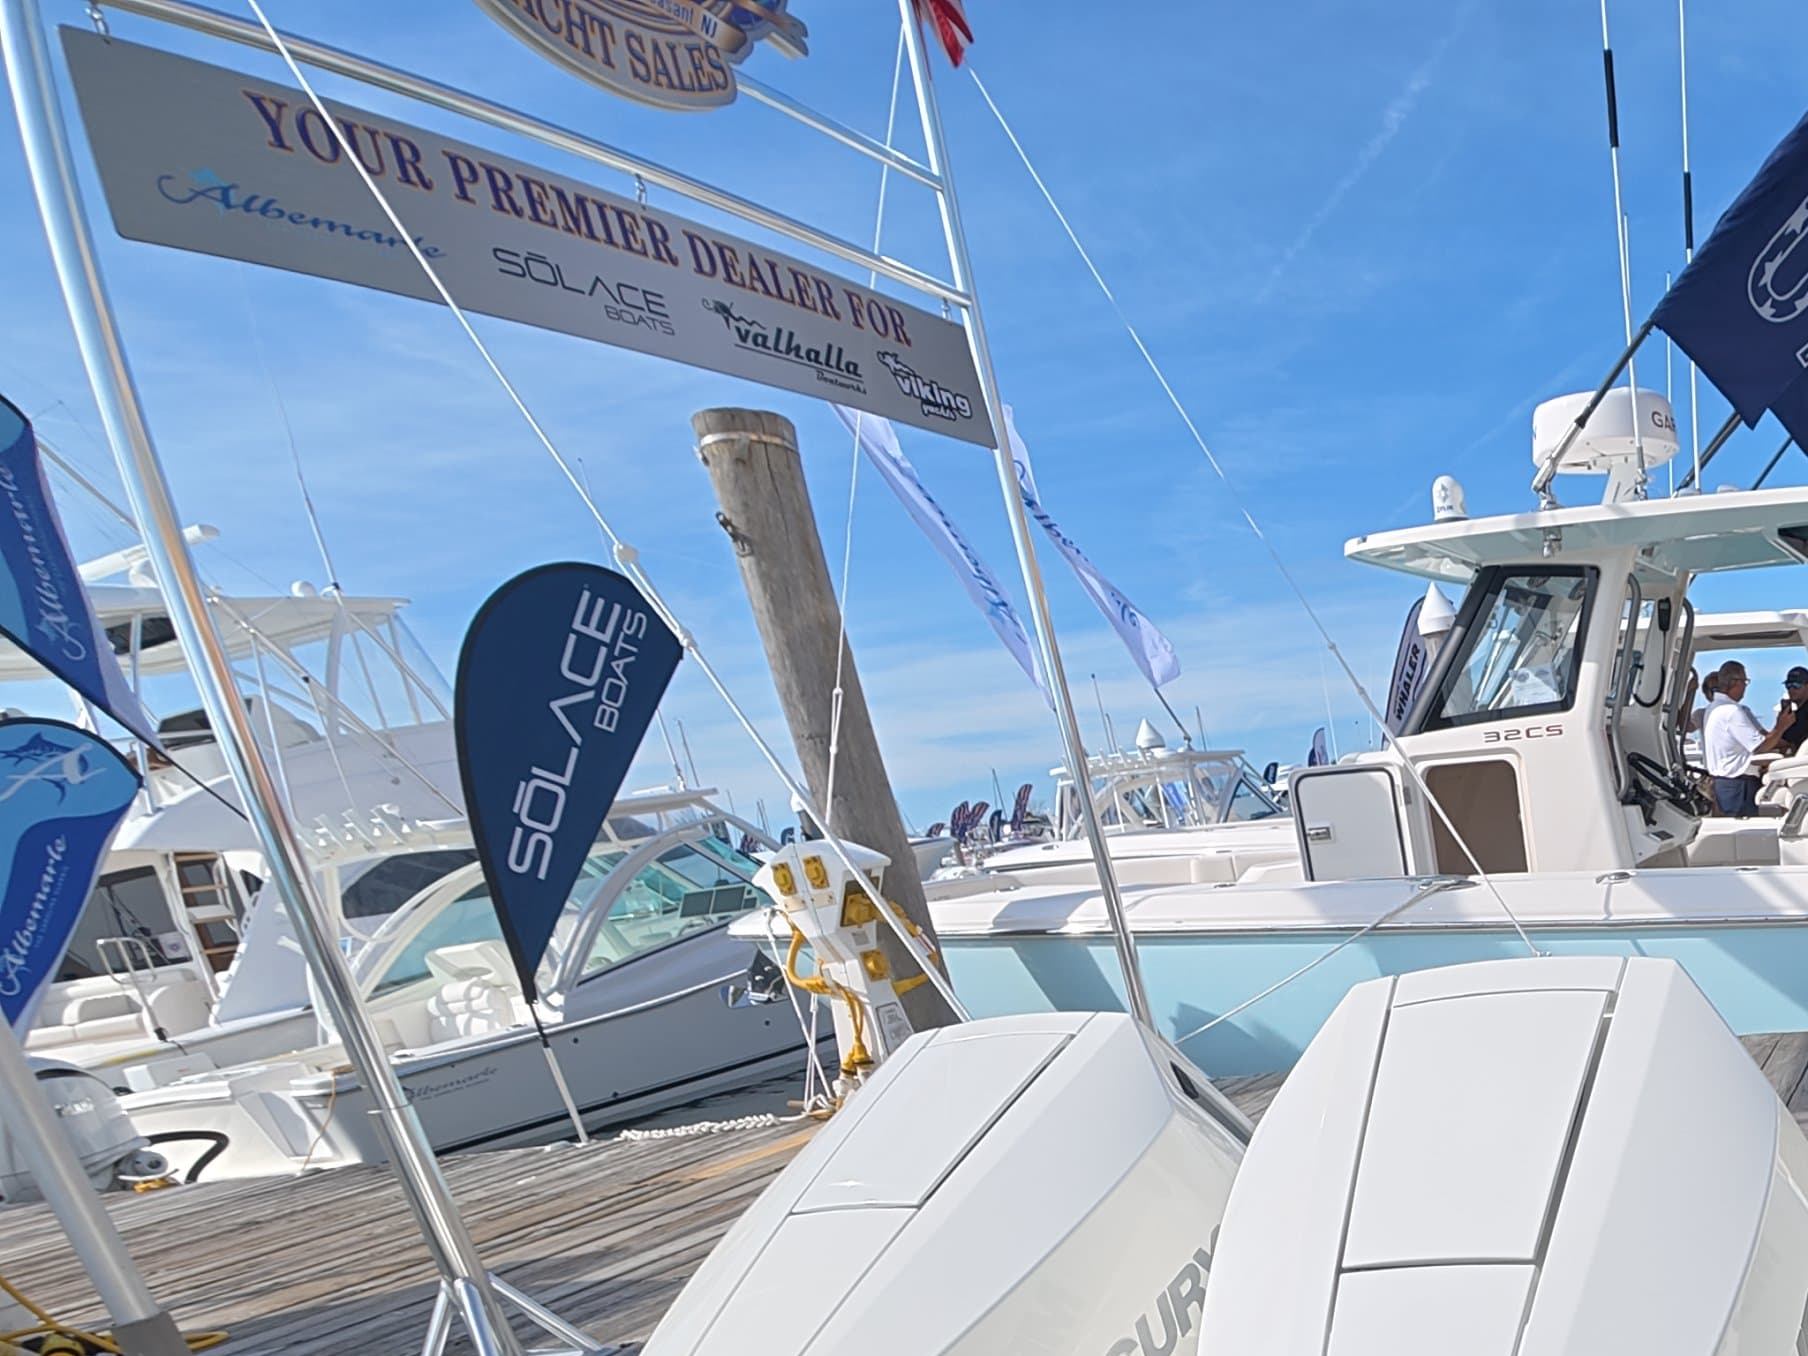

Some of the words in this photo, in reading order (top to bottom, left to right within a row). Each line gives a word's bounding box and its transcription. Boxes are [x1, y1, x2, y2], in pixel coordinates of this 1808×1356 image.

[514, 0, 616, 69] CHT
[624, 29, 728, 92] SALES
[700, 16, 718, 39] NJ
[242, 89, 434, 192] YOUR
[441, 149, 679, 268] PREMIER
[682, 229, 841, 322] DEALER
[842, 288, 913, 348] FOR
[604, 304, 675, 336] BOATS
[735, 325, 863, 378] valhalla
[594, 608, 647, 733] BOATS
[1395, 643, 1421, 721] WHALER
[1483, 723, 1564, 743] 32CS
